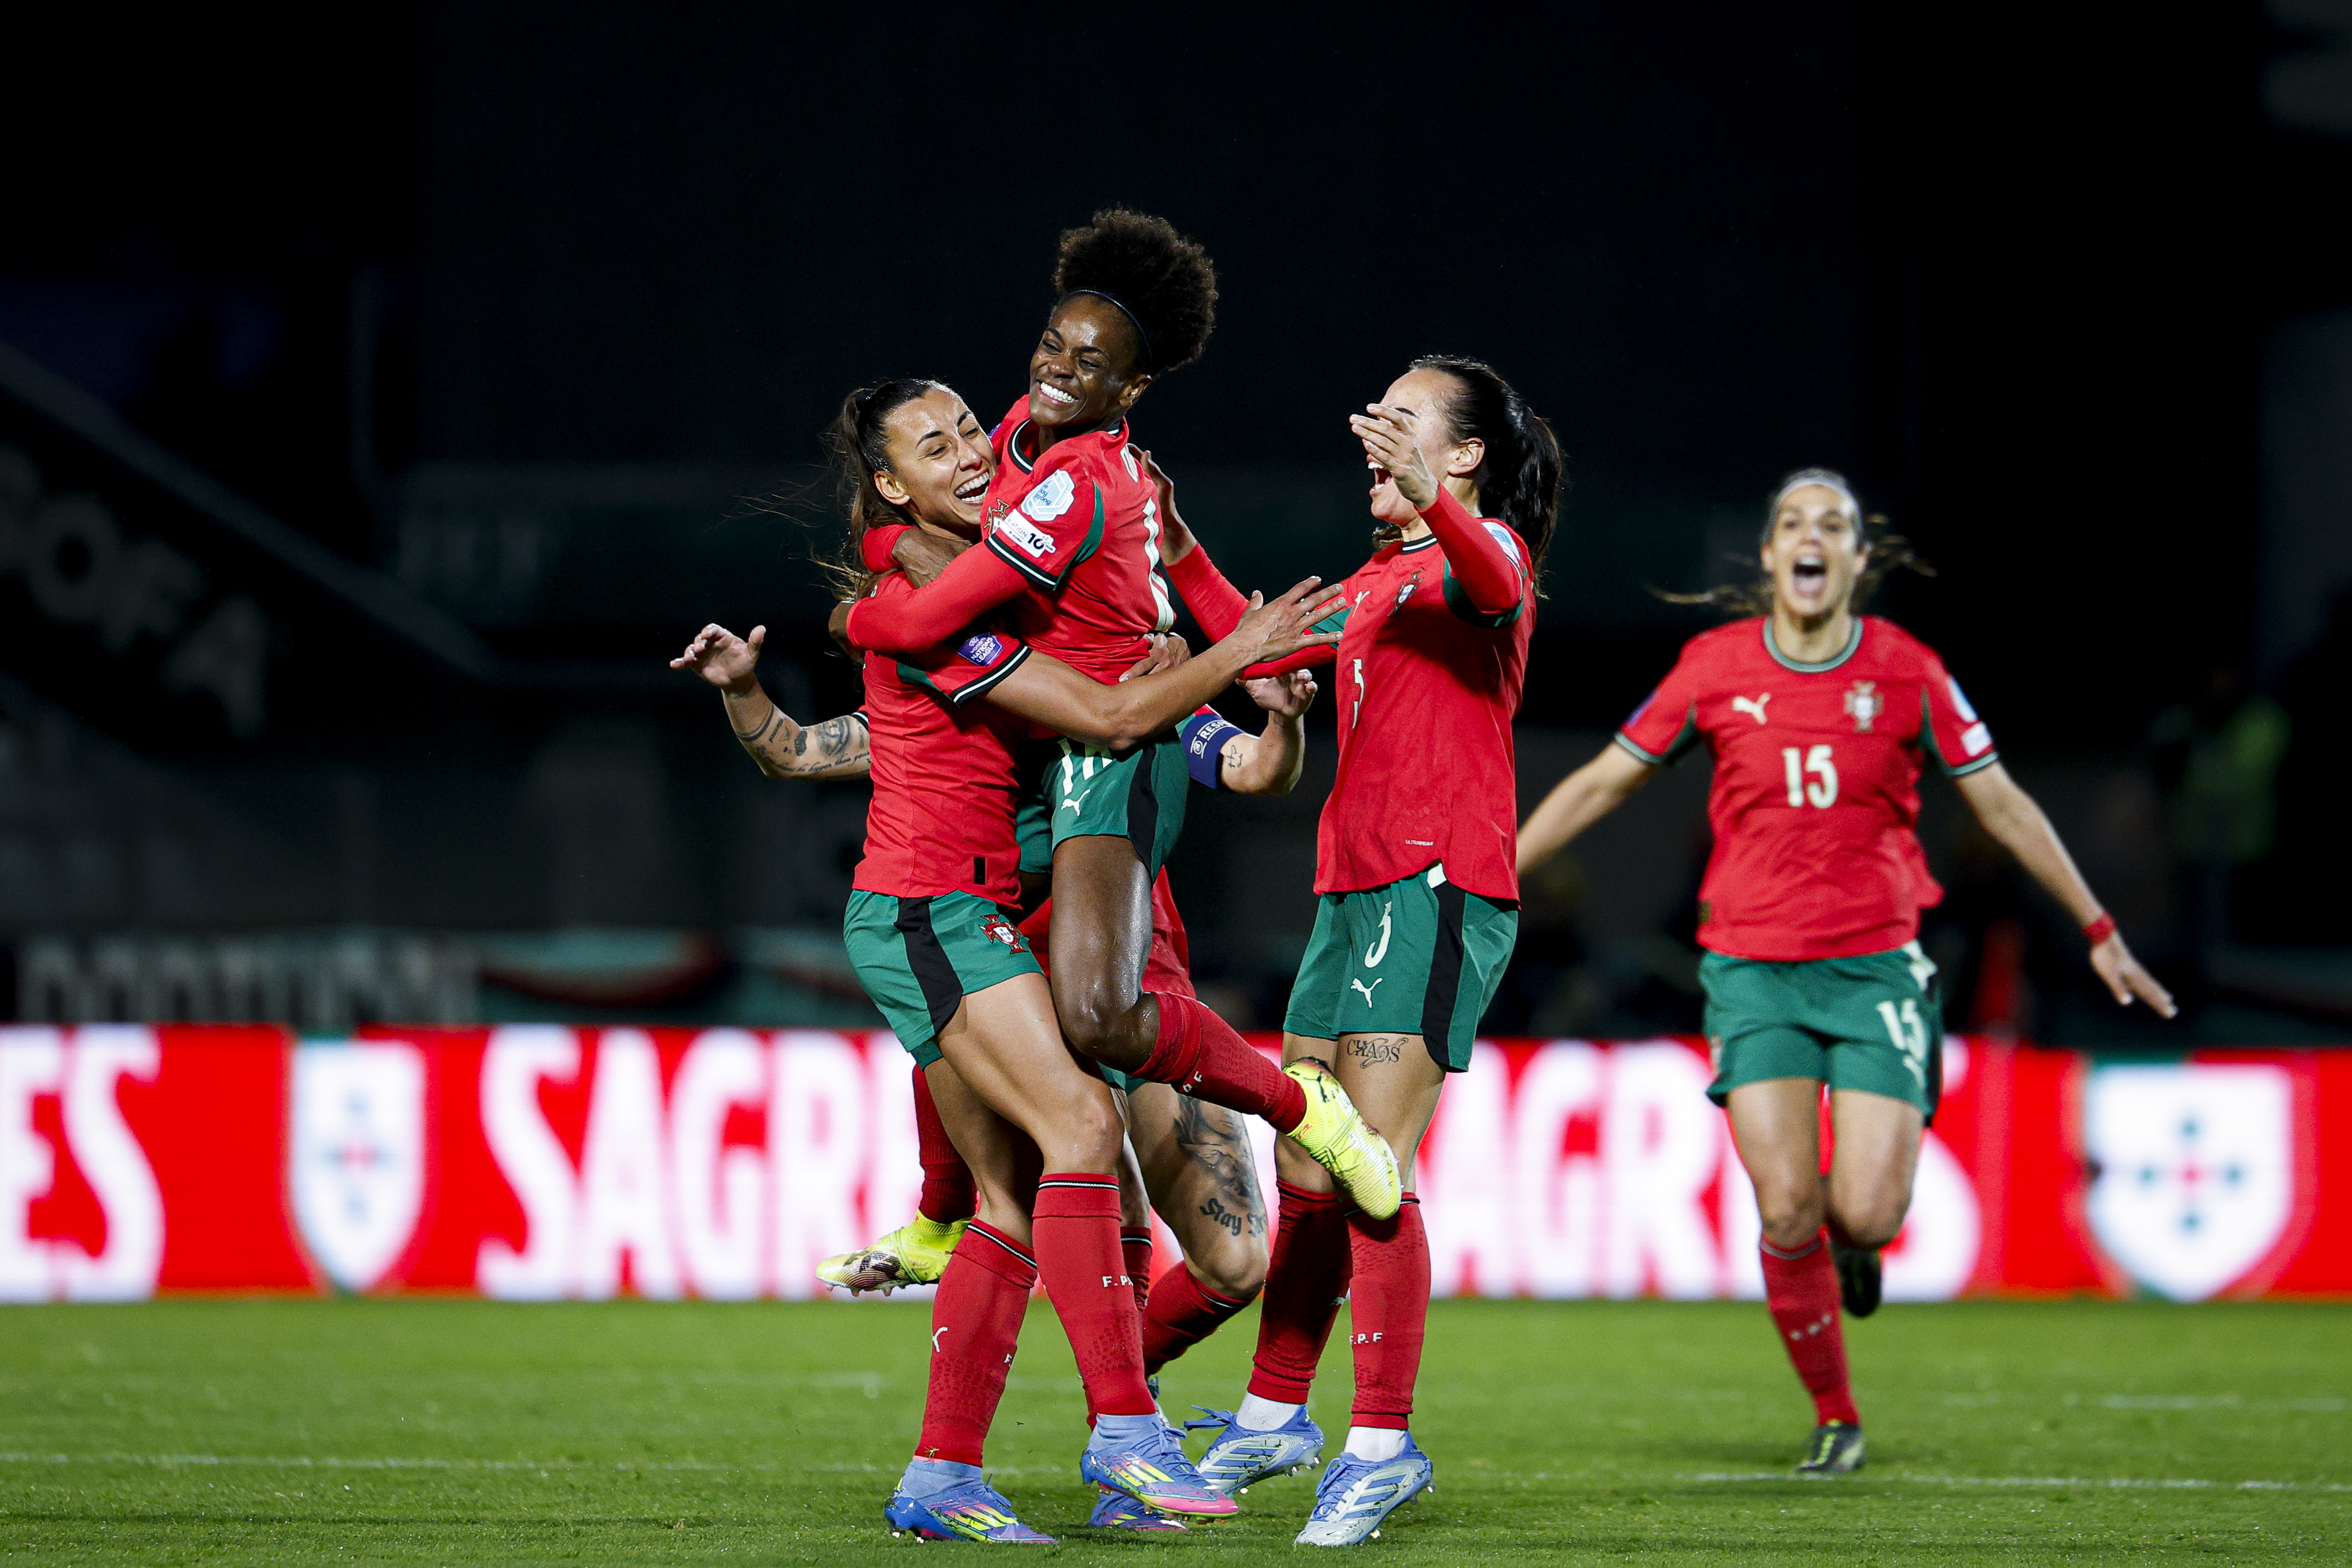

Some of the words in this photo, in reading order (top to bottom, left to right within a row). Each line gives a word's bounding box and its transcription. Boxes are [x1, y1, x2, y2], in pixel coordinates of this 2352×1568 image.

[971, 636, 994, 660] NATIONS
[976, 641, 996, 663] LEAGUE
[1781, 743, 1839, 809] 15
[1876, 998, 1929, 1064] 15
[1199, 1197, 1242, 1236] Stay
